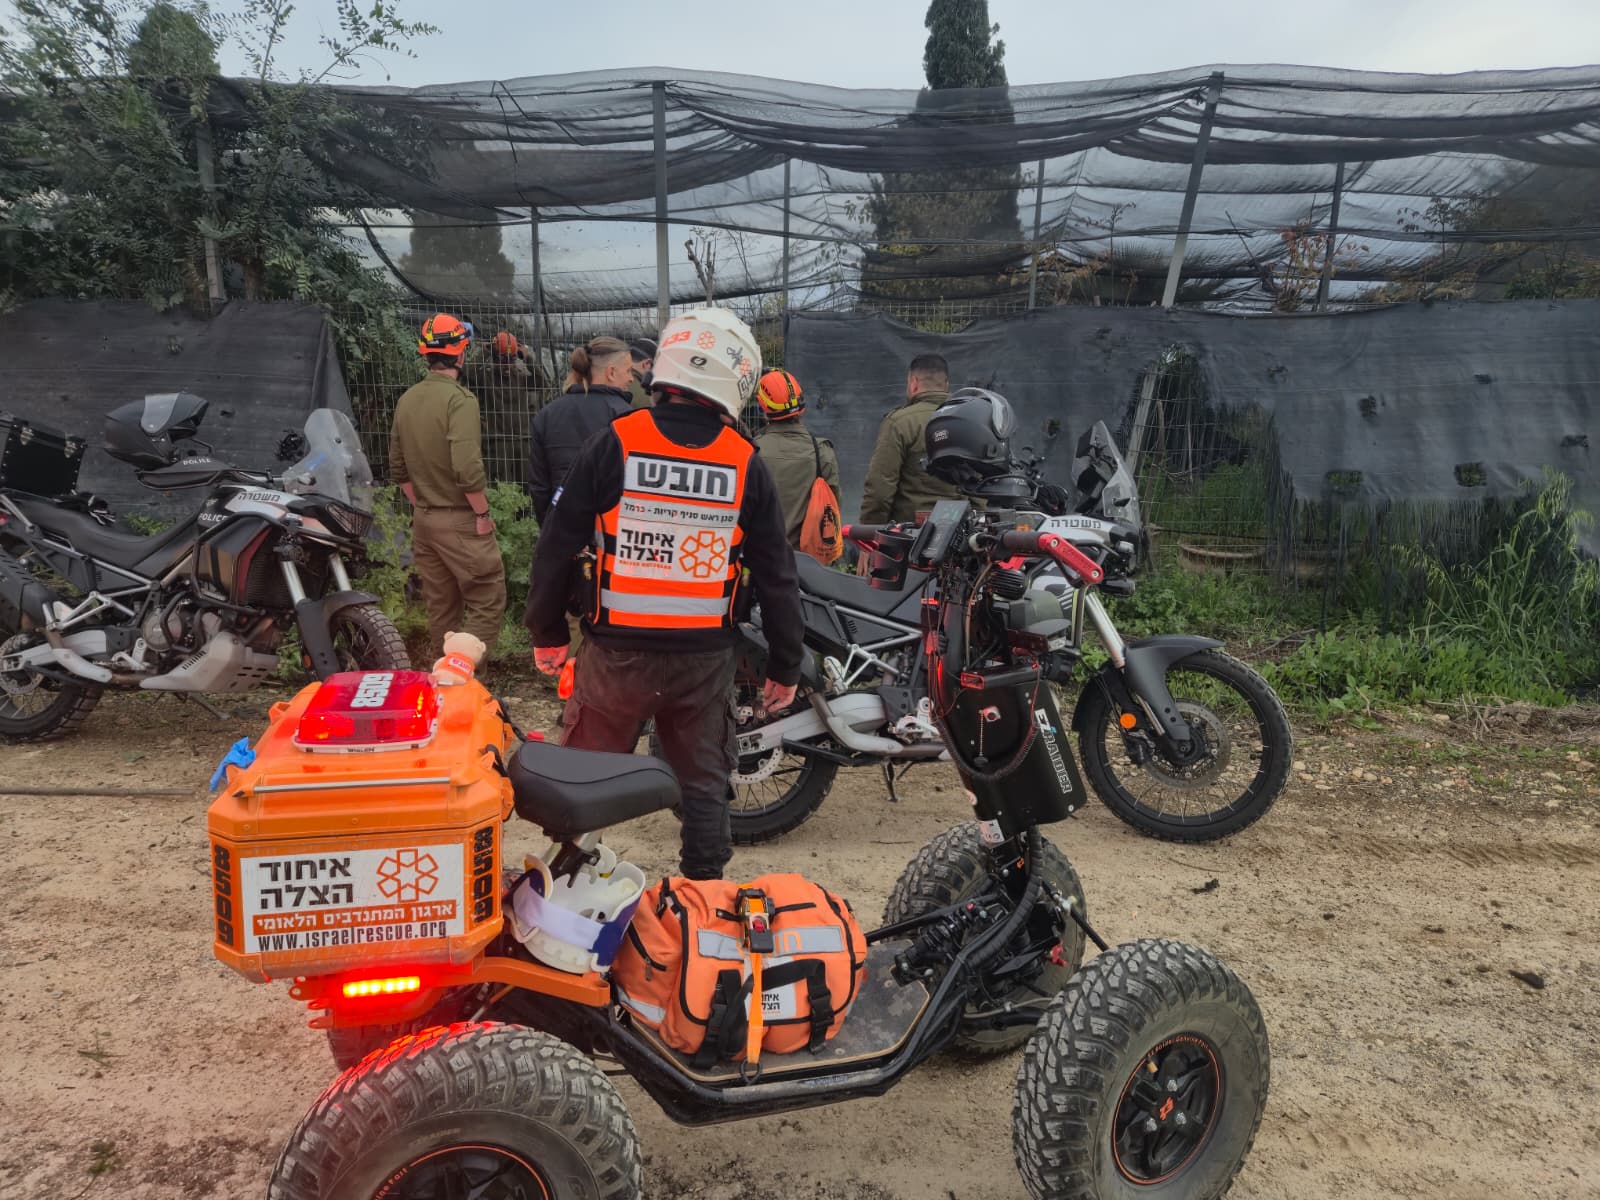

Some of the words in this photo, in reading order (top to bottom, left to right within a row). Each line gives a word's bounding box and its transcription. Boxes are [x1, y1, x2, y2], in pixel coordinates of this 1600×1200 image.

[637, 461, 729, 497] חובש
[238, 492, 281, 502] משטרה
[623, 502, 645, 513] כרמל
[653, 507, 678, 517] קריות
[680, 510, 699, 520] סניף
[700, 511, 719, 521] ראש
[1050, 519, 1102, 529] משטרה
[621, 528, 675, 548] איחוד
[619, 545, 674, 564] הצלה
[259, 858, 352, 882] איחוד
[473, 826, 494, 924] 8509
[214, 844, 234, 947] 8509
[260, 883, 354, 909] הצלה
[323, 908, 405, 925] המתנדבים
[411, 904, 452, 921] ארגון
[257, 913, 317, 930] הלאומי
[258, 921, 447, 952] www.israelrescue.org
